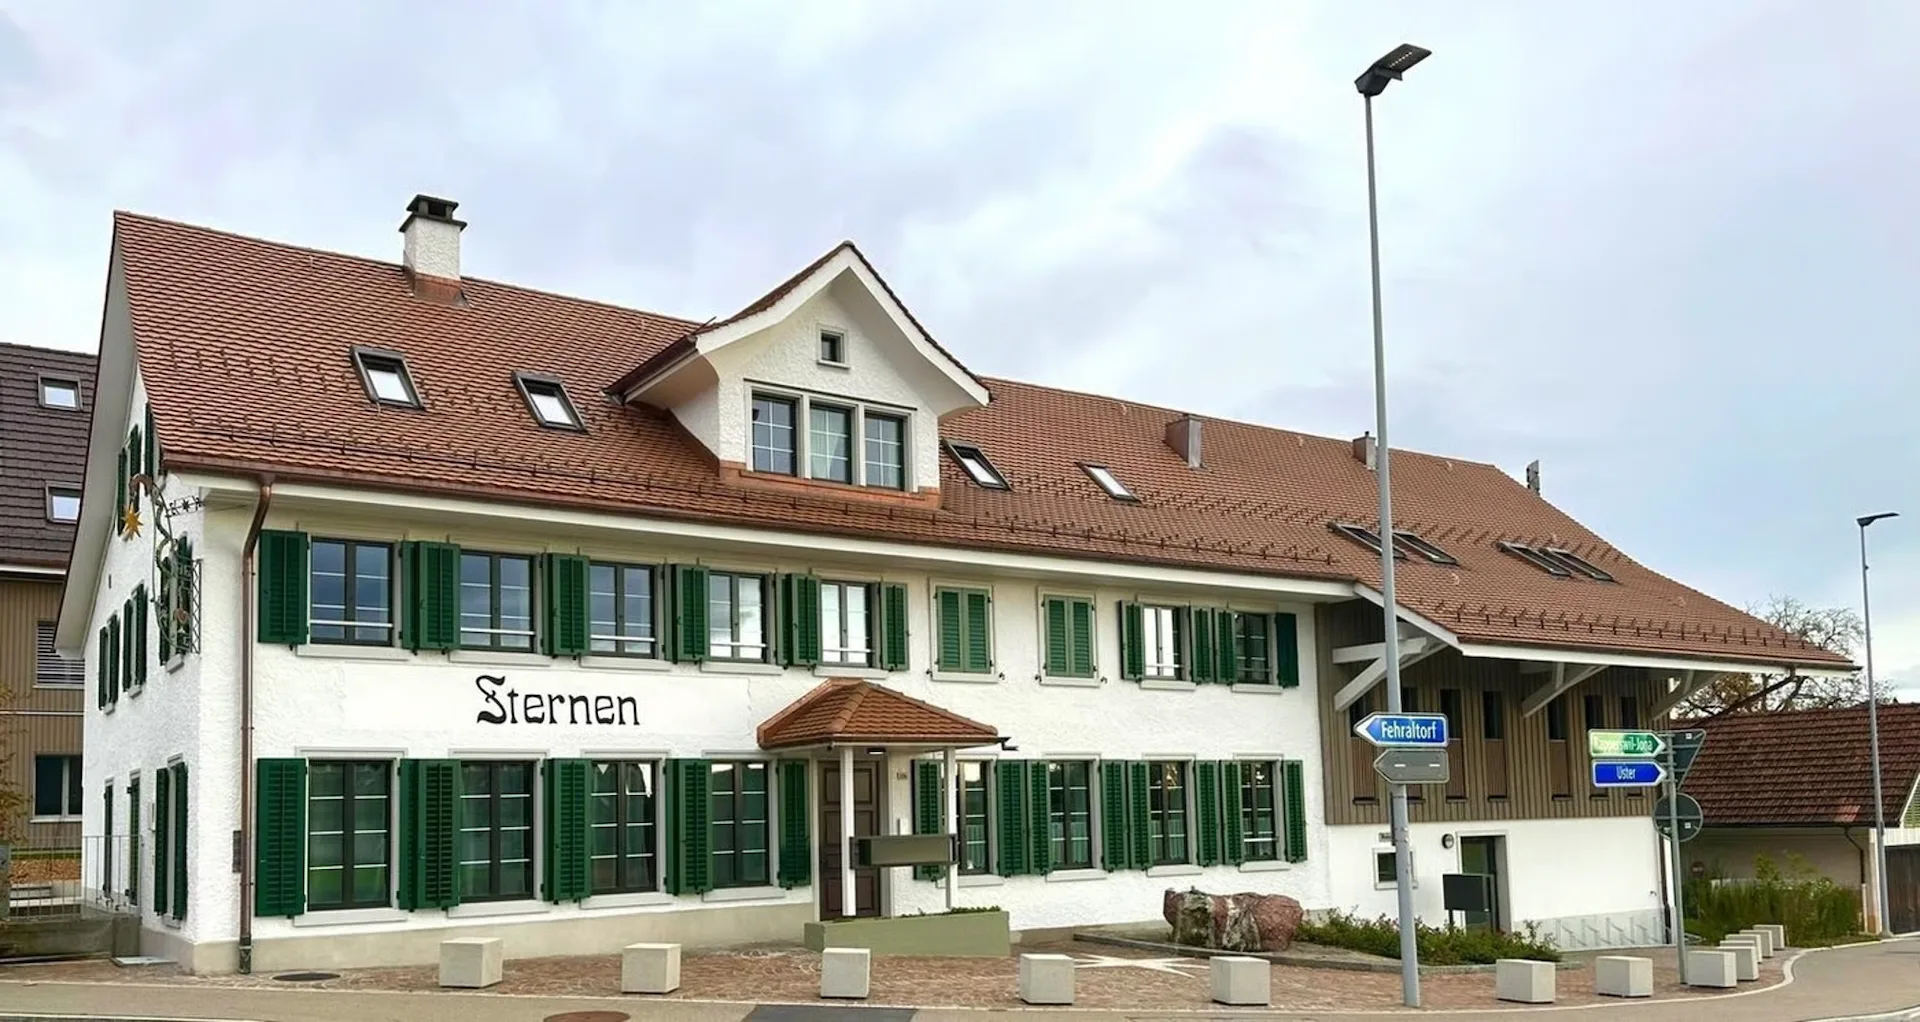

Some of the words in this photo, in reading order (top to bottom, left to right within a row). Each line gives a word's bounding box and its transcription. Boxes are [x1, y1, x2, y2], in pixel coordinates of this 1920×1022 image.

[475, 674, 640, 726] Sternen
[1381, 720, 1437, 739] Fehraltorf
[1616, 766, 1636, 780] Uster
